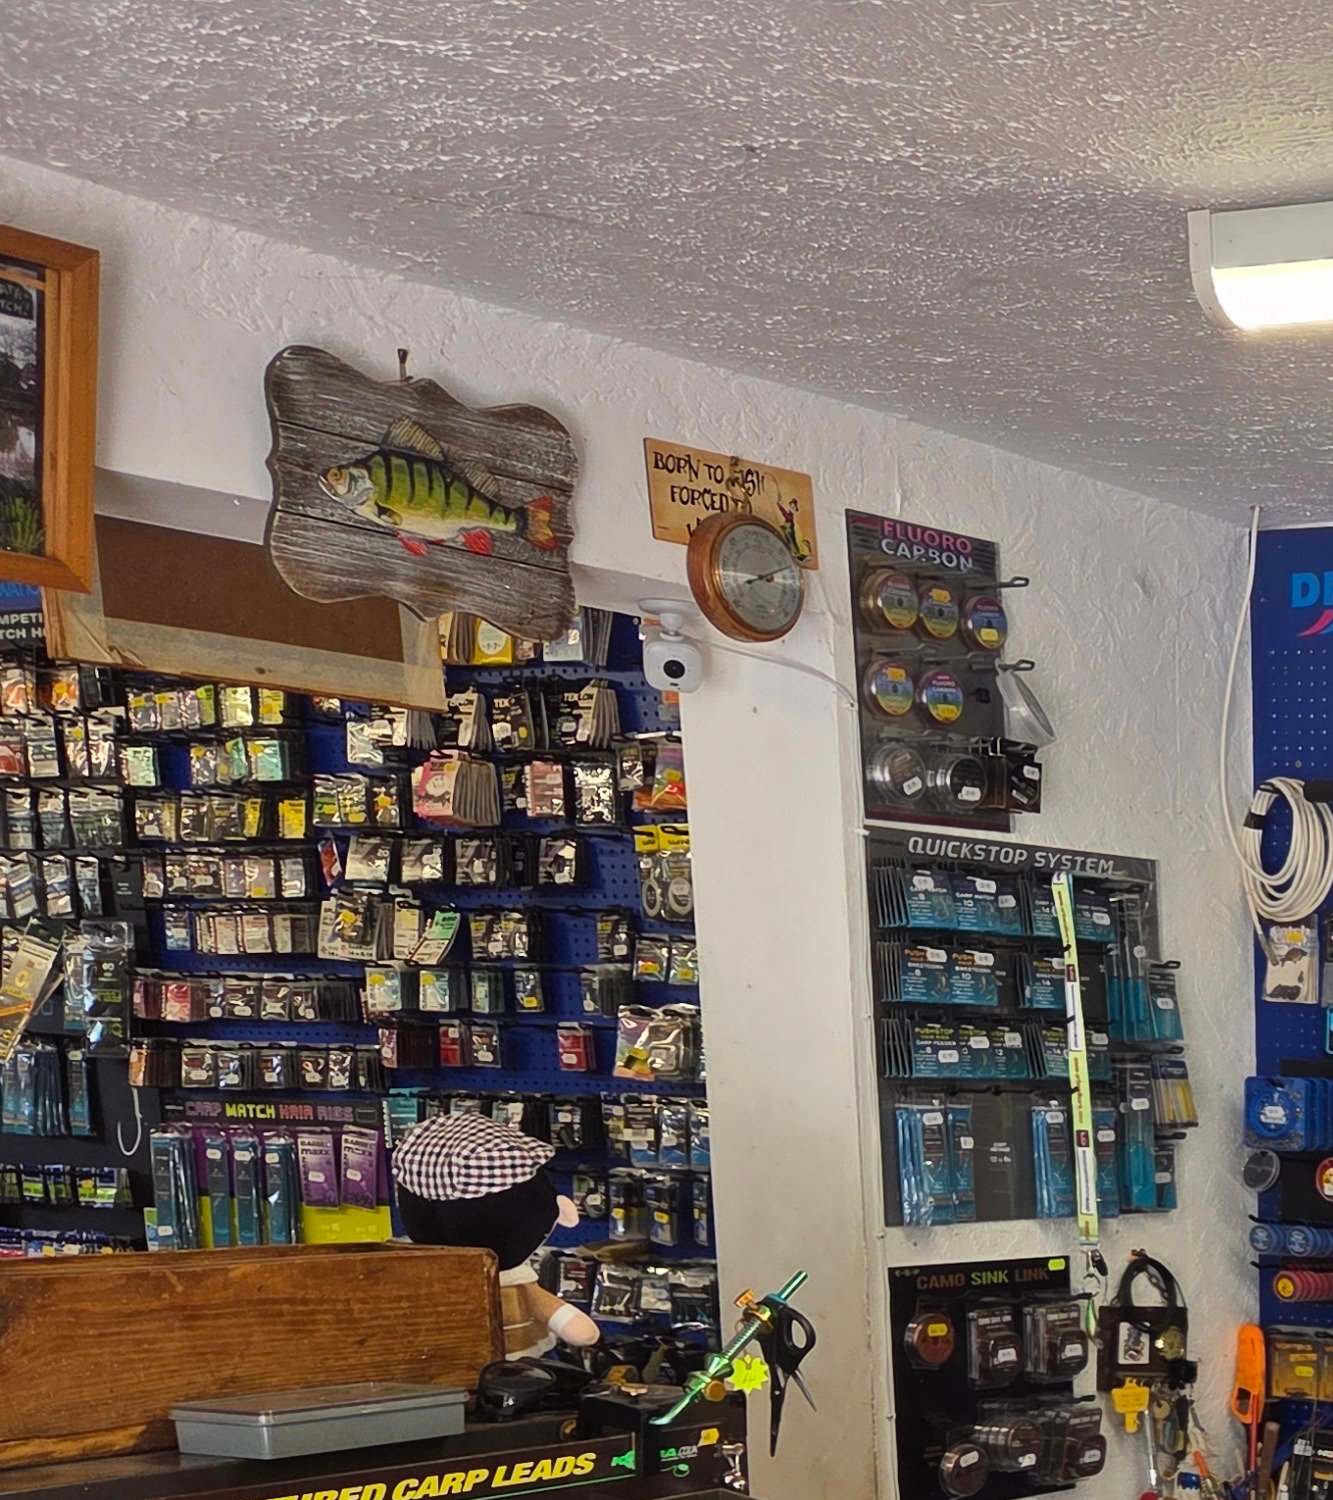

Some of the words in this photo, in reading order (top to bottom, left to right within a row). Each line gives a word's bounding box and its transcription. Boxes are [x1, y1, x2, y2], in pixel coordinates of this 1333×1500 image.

[653, 452, 700, 482] BORN
[703, 463, 724, 483] TO
[671, 485, 730, 513] FORCED
[883, 520, 972, 554] FLUORO
[881, 538, 973, 572] CARBON
[908, 837, 1028, 865] QUICKSTOP
[1034, 850, 1115, 875] SYSTEM
[225, 1103, 275, 1119] MATCH
[279, 1103, 313, 1120] HAIR
[917, 1274, 966, 1289] CAMO
[971, 1269, 1009, 1285] SINK
[1014, 1267, 1050, 1282] LINK
[492, 1453, 596, 1488] LEADS
